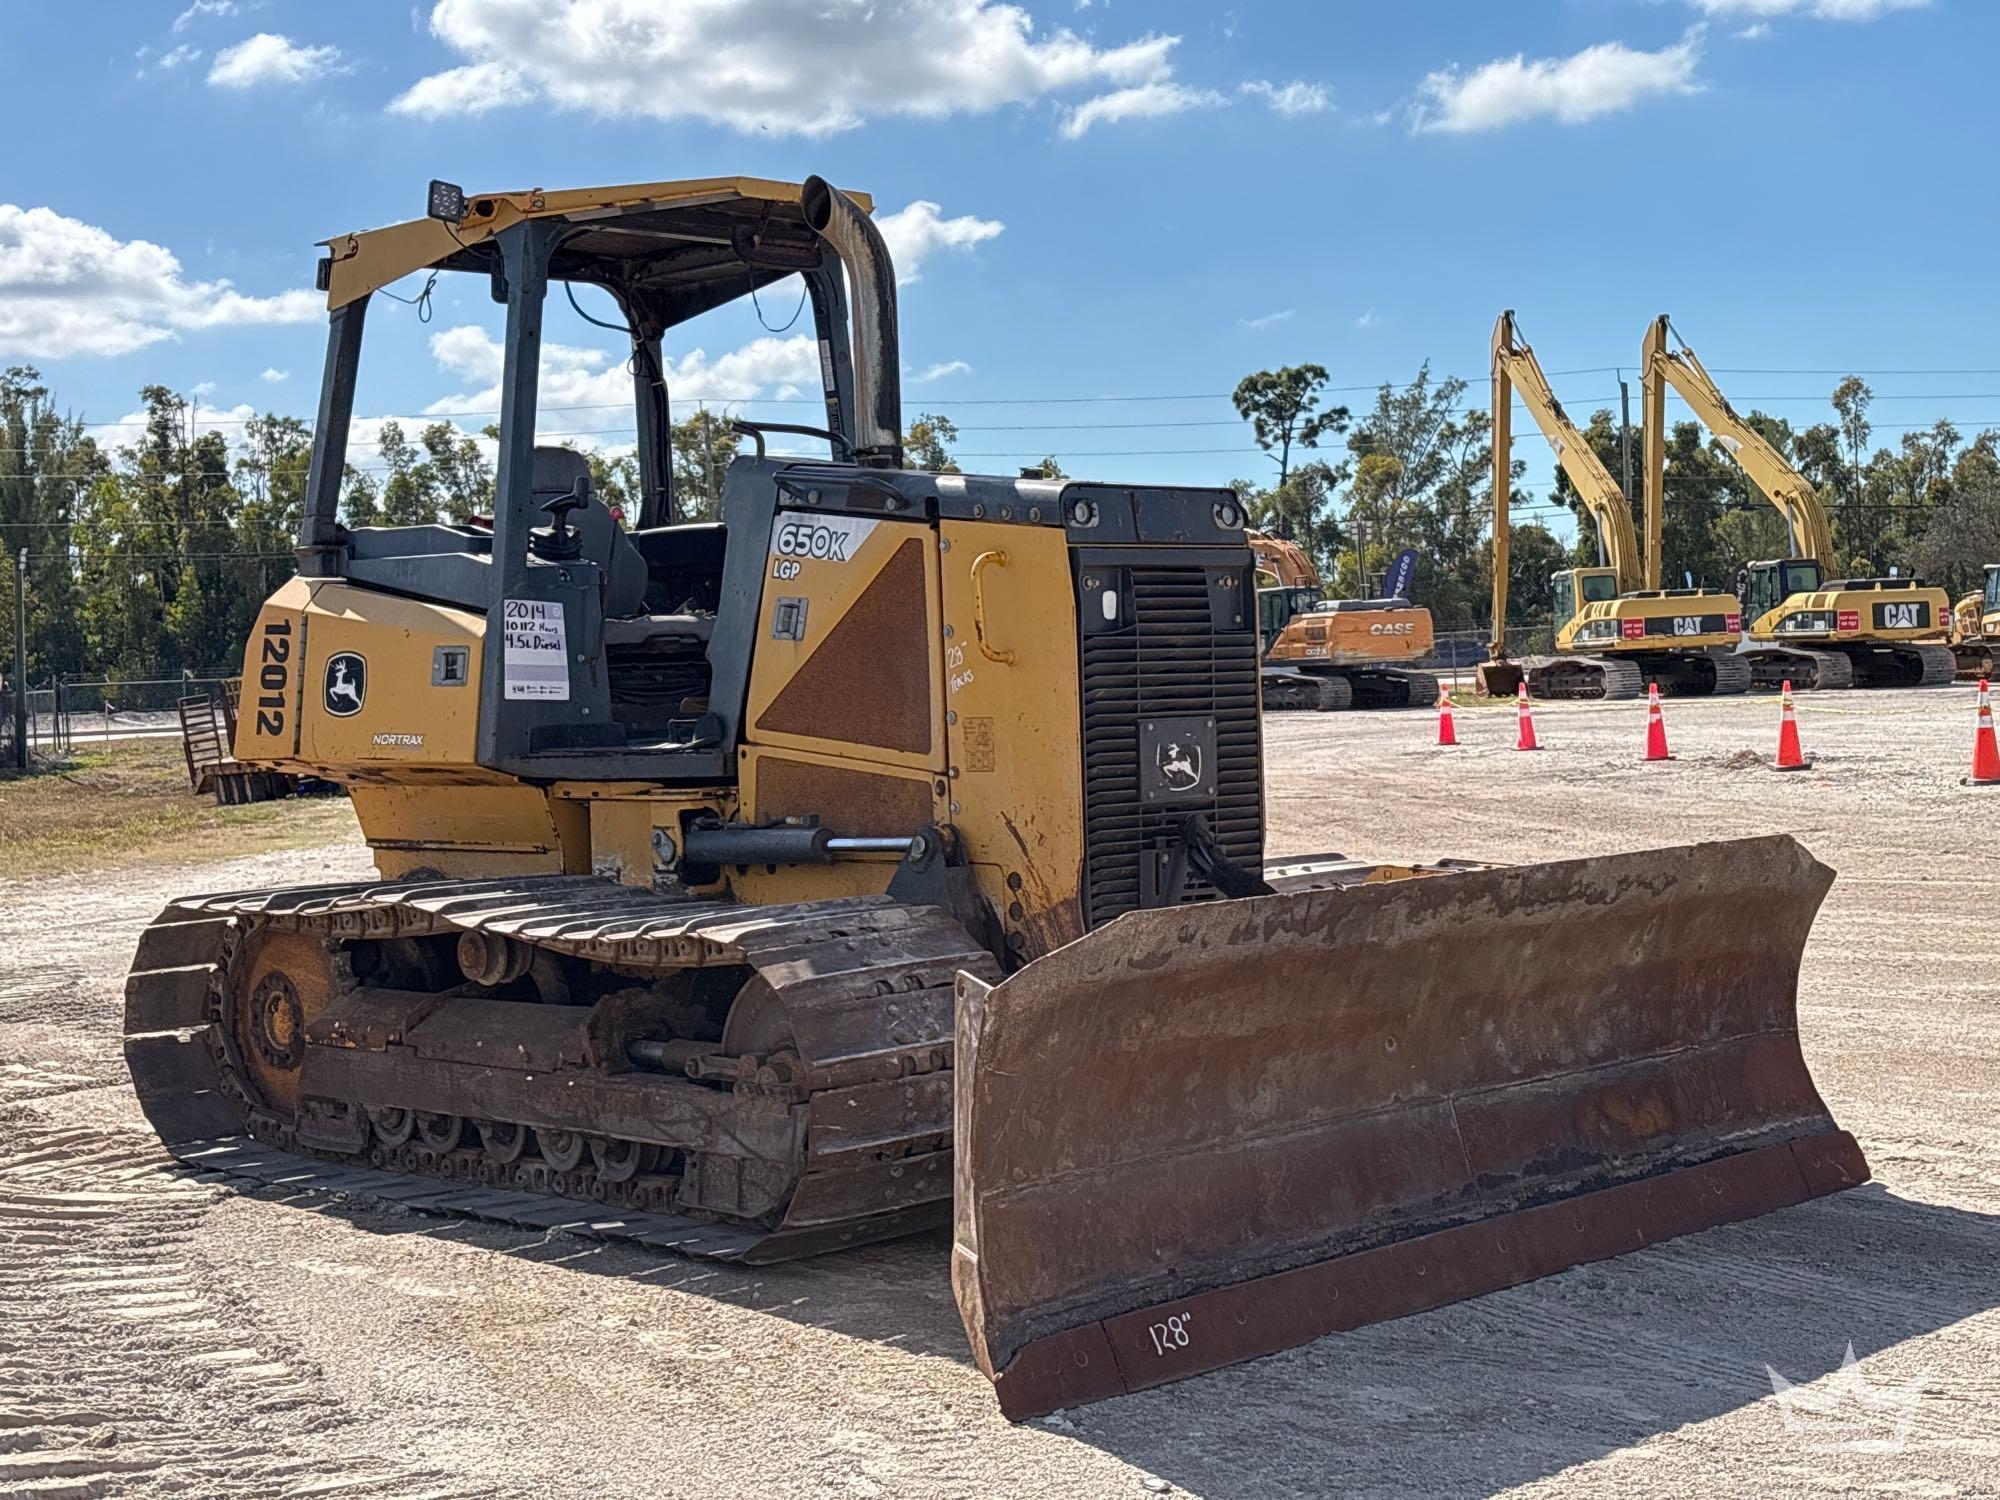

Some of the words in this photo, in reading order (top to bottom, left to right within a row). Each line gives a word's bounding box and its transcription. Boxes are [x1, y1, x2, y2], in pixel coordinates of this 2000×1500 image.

[778, 523, 850, 561] 650K
[772, 558, 801, 581] LGP
[506, 601, 545, 619] 2014
[1884, 603, 1920, 629] CAT
[1369, 622, 1415, 636] CASE
[1673, 616, 1702, 635] CAT
[533, 635, 561, 650] Diesel
[256, 619, 291, 736] 12012
[372, 733, 424, 746] NORTRAX
[1149, 1311, 1191, 1356] 128"
